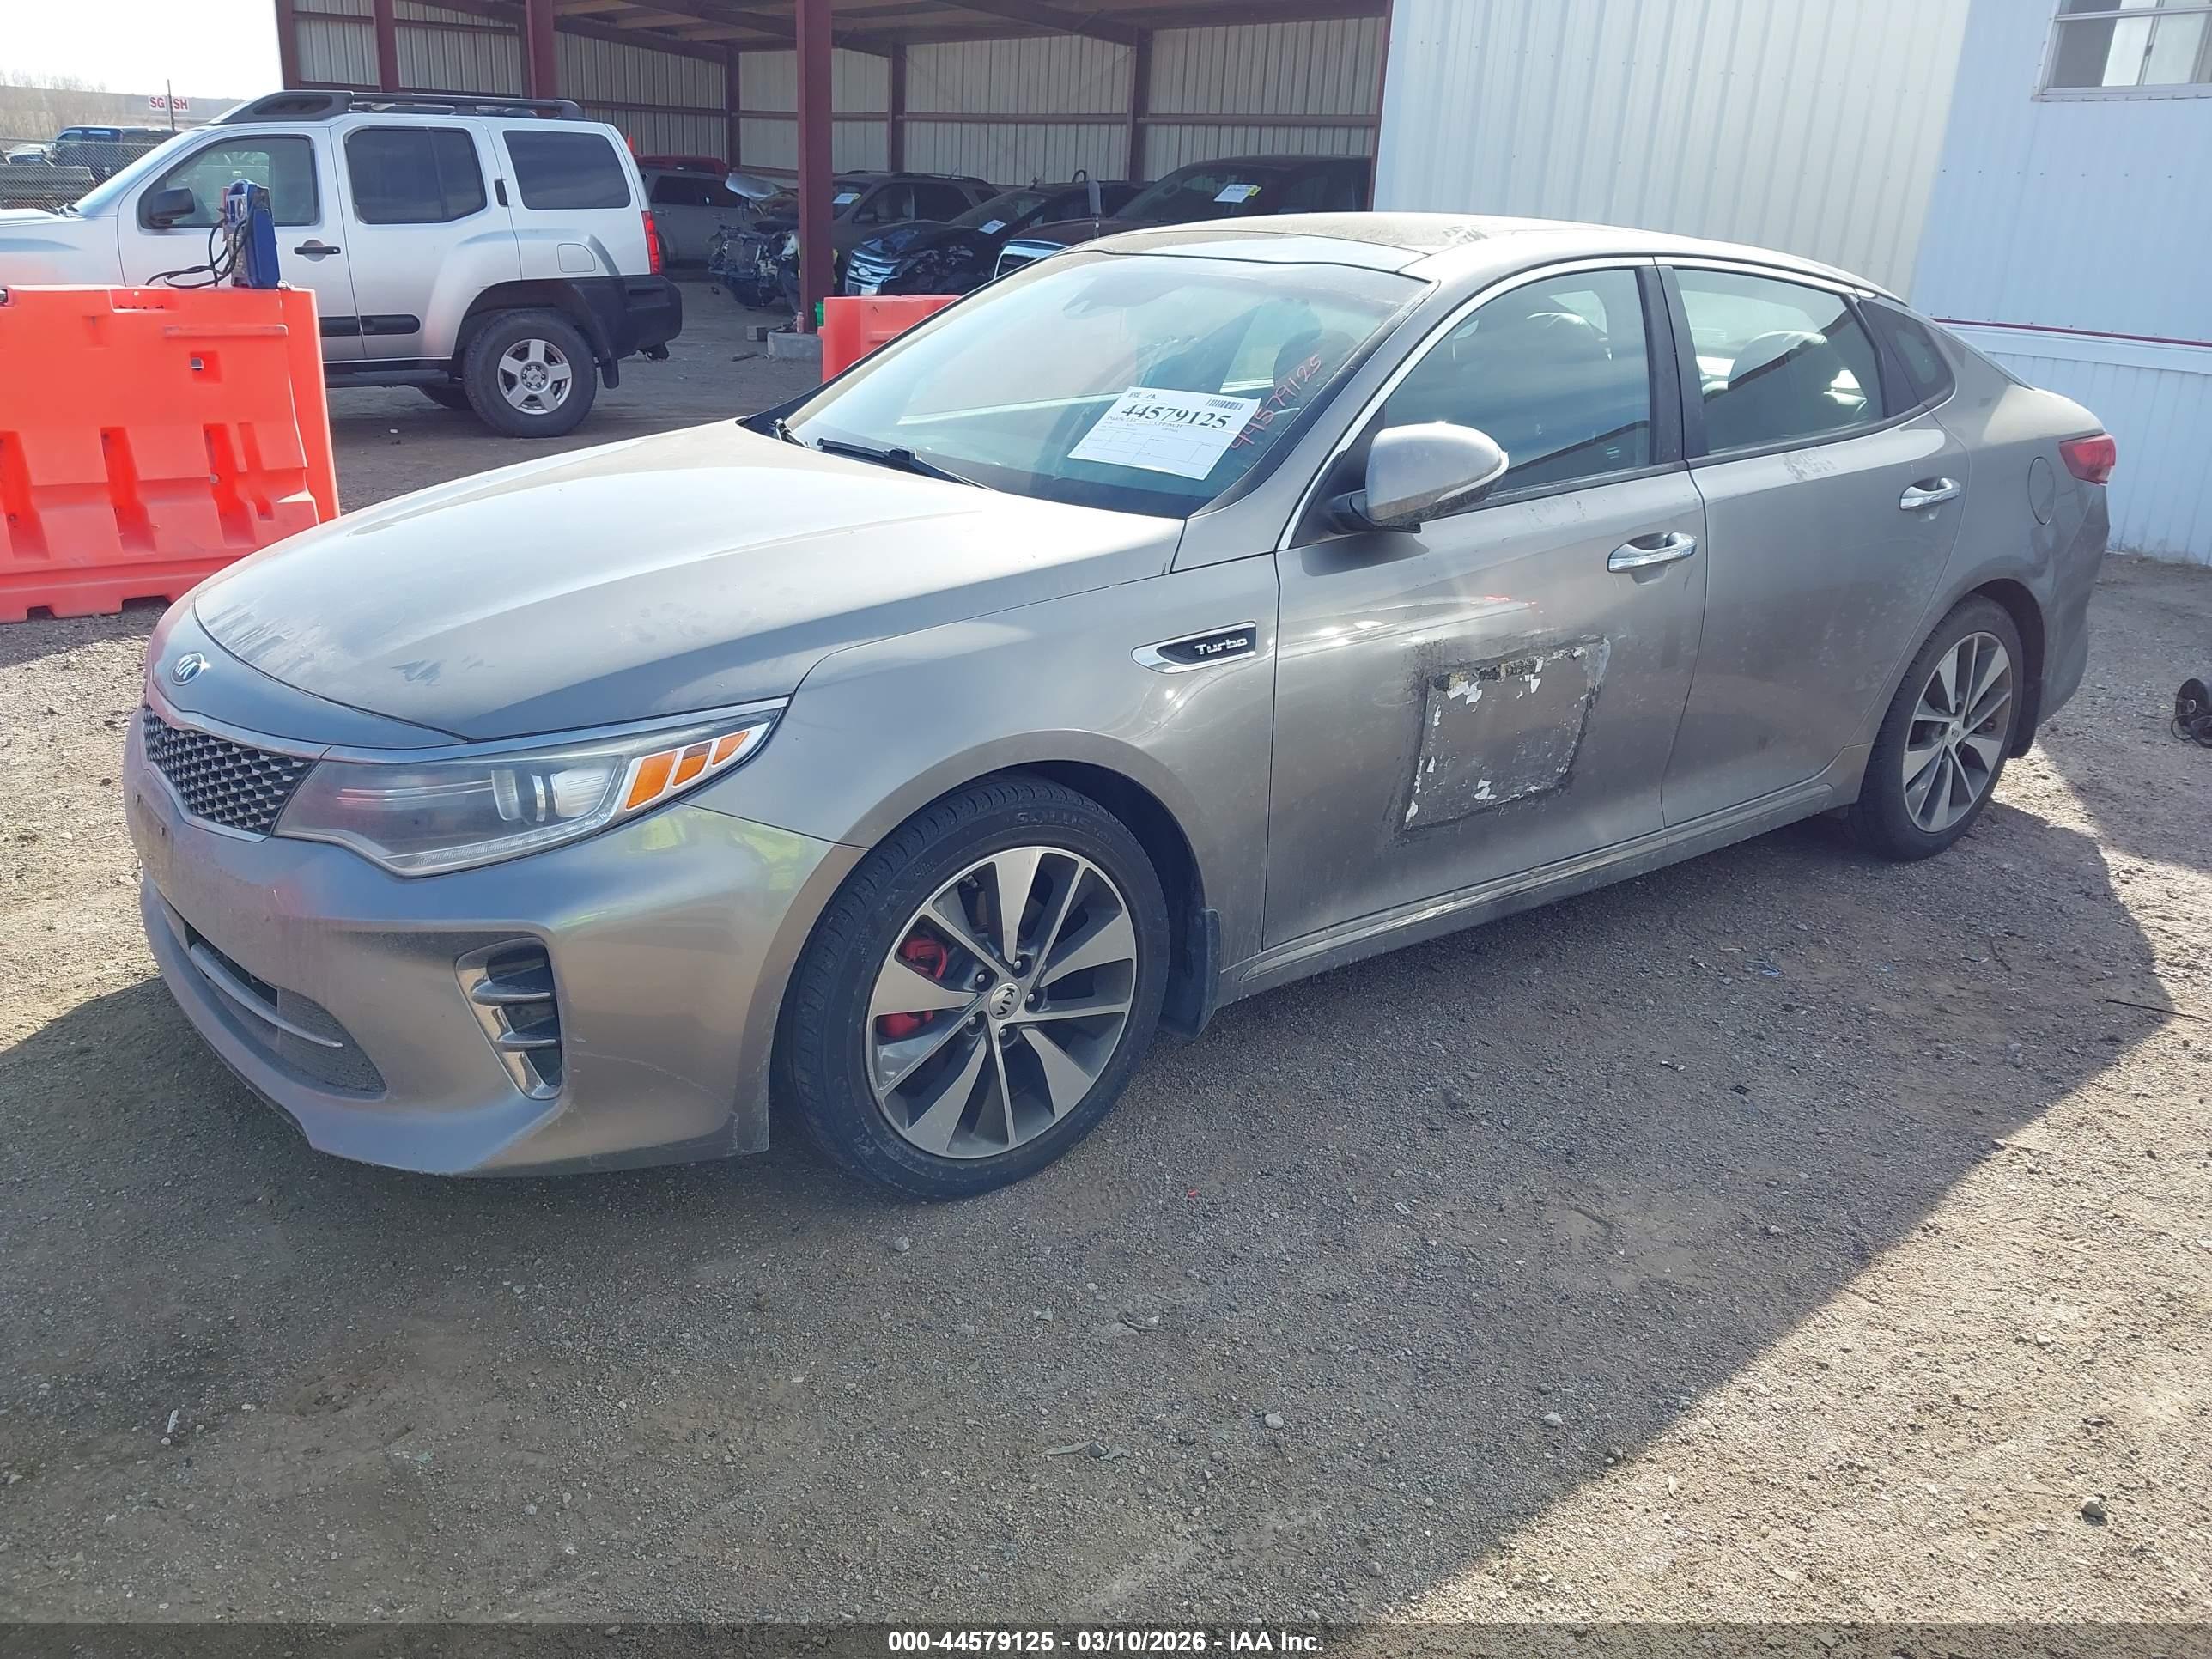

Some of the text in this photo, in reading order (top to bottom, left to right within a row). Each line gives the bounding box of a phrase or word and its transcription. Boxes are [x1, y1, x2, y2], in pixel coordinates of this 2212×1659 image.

[1231, 354, 1322, 448] 44579125
[1121, 404, 1232, 429] 44579125
[1194, 637, 1248, 655] Turbo
[996, 987, 1016, 1016] KIA
